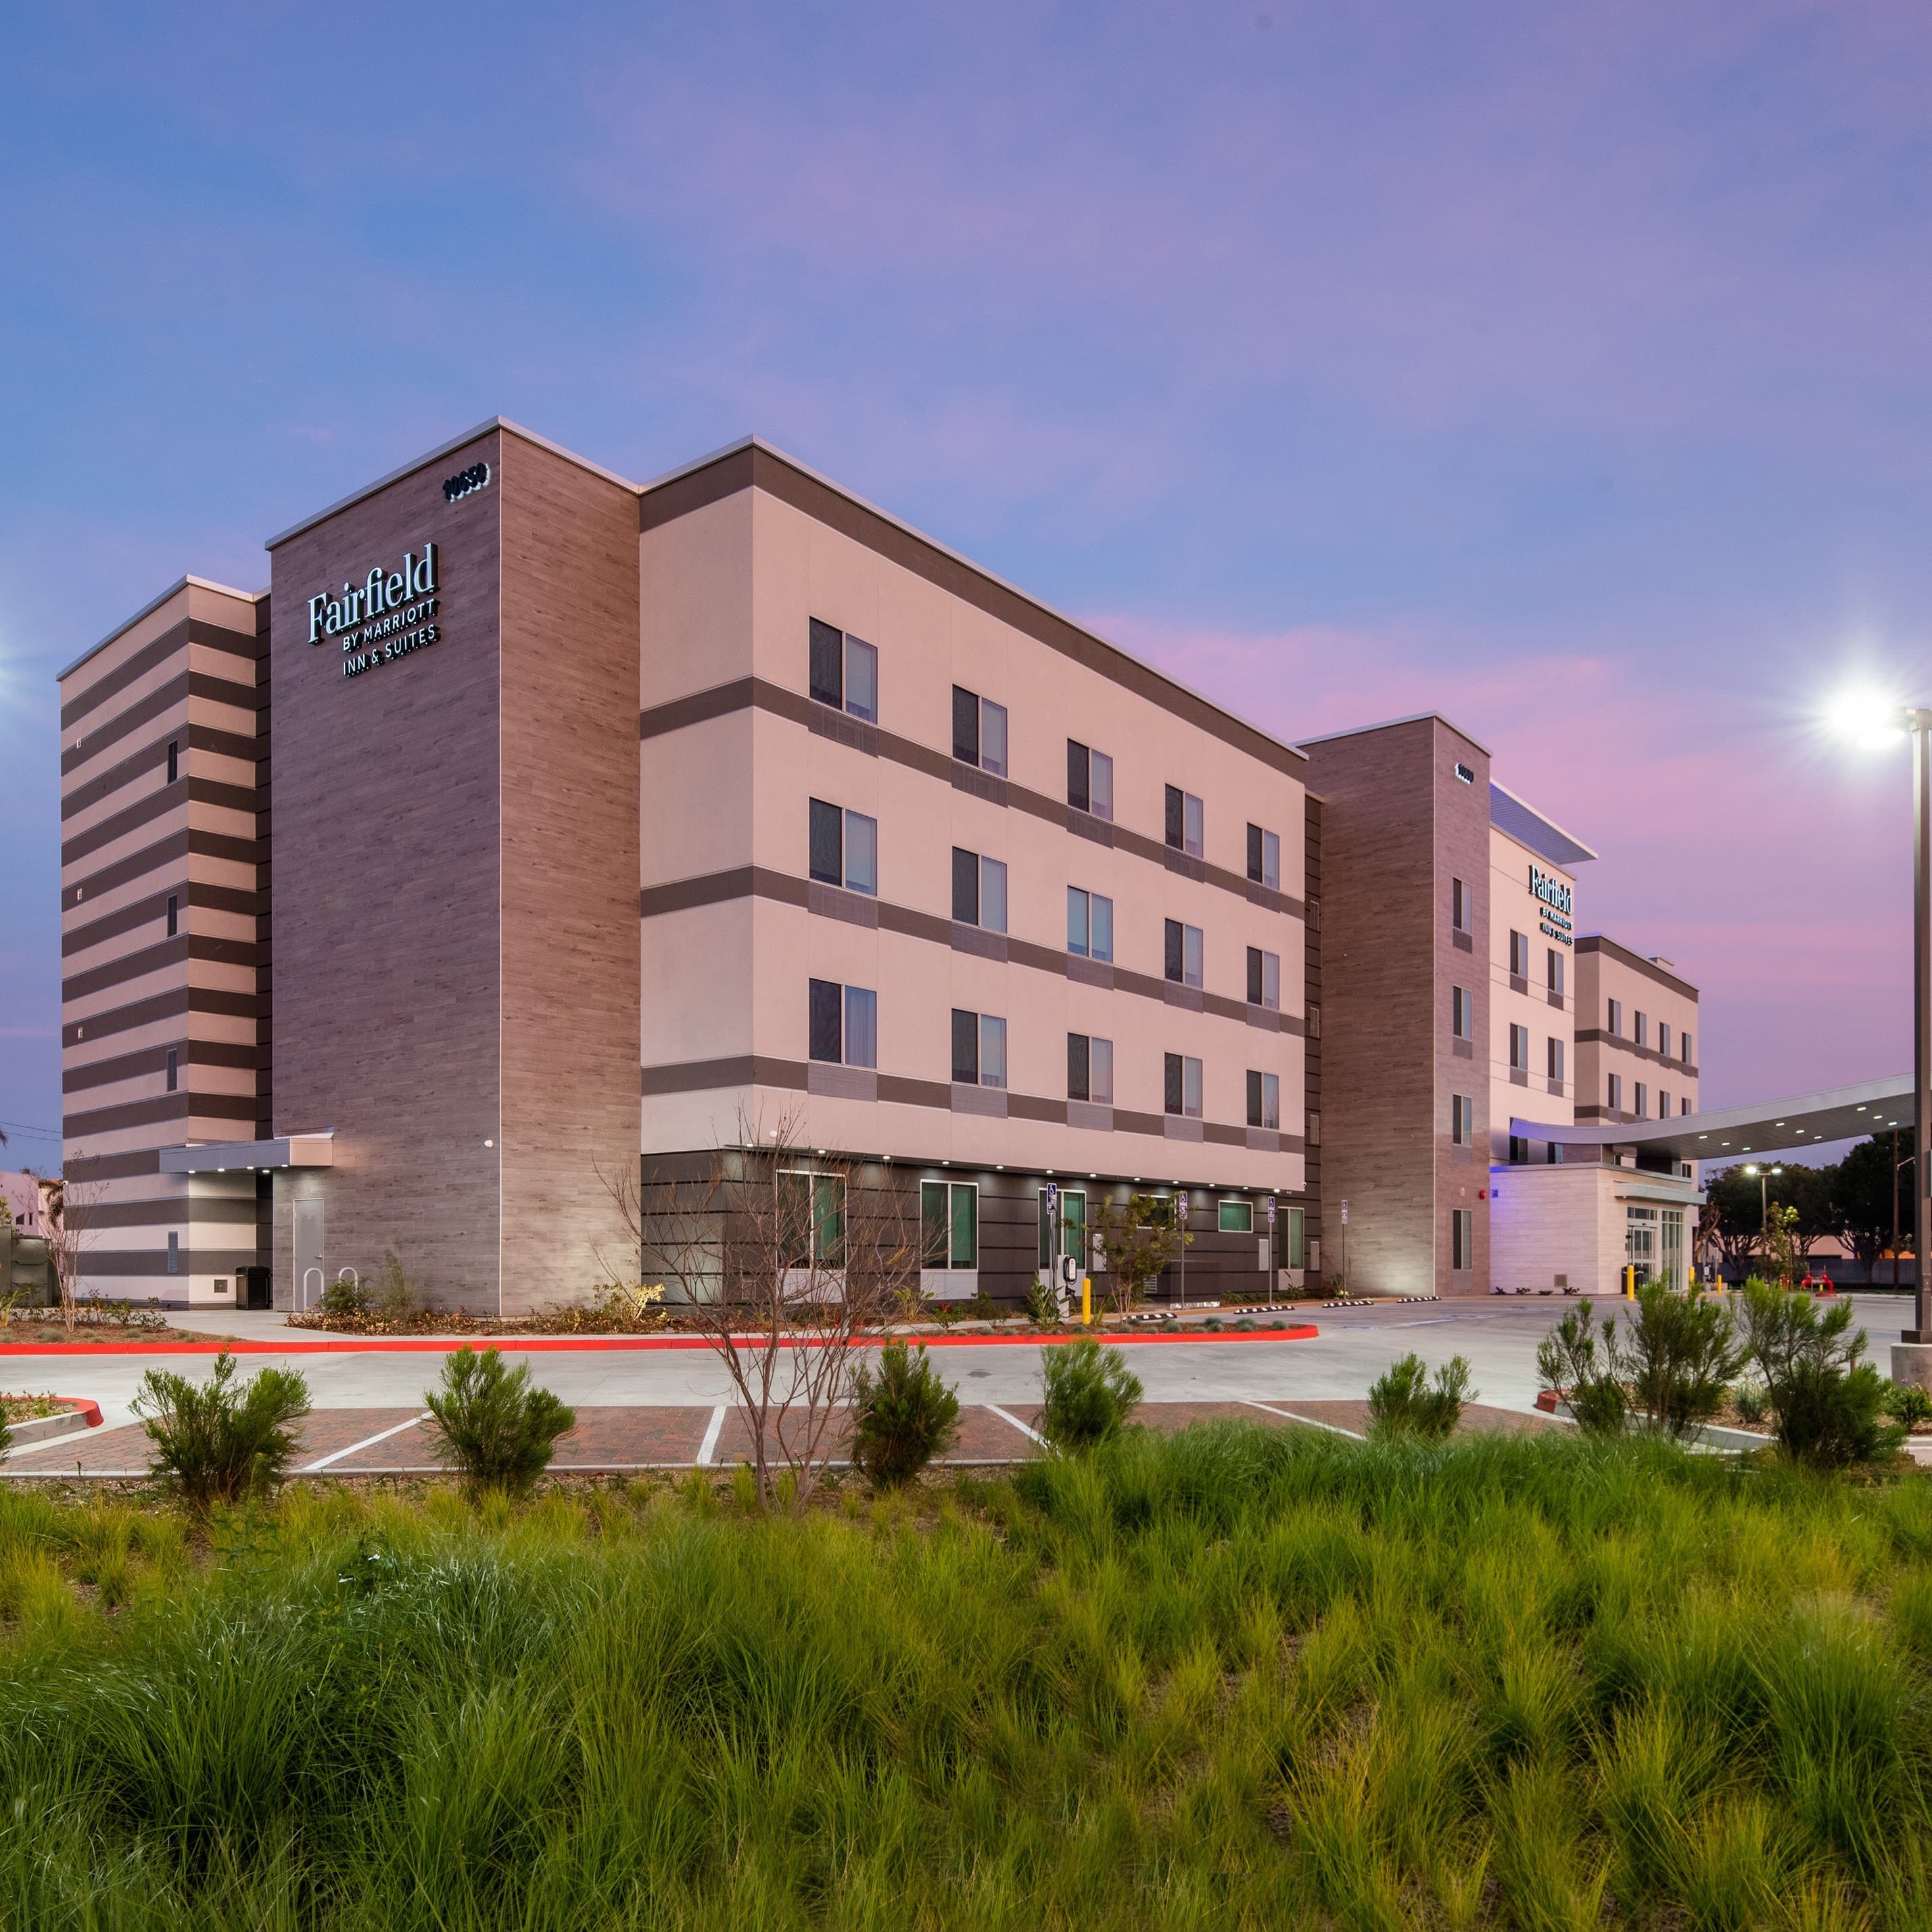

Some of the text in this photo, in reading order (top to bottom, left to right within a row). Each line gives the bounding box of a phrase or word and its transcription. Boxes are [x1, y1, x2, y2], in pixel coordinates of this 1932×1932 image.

[308, 542, 438, 644] Fairfield
[343, 598, 437, 651] BY MARRIOTT
[343, 623, 437, 676] INN & SUITES
[1530, 864, 1574, 916] Fairfield
